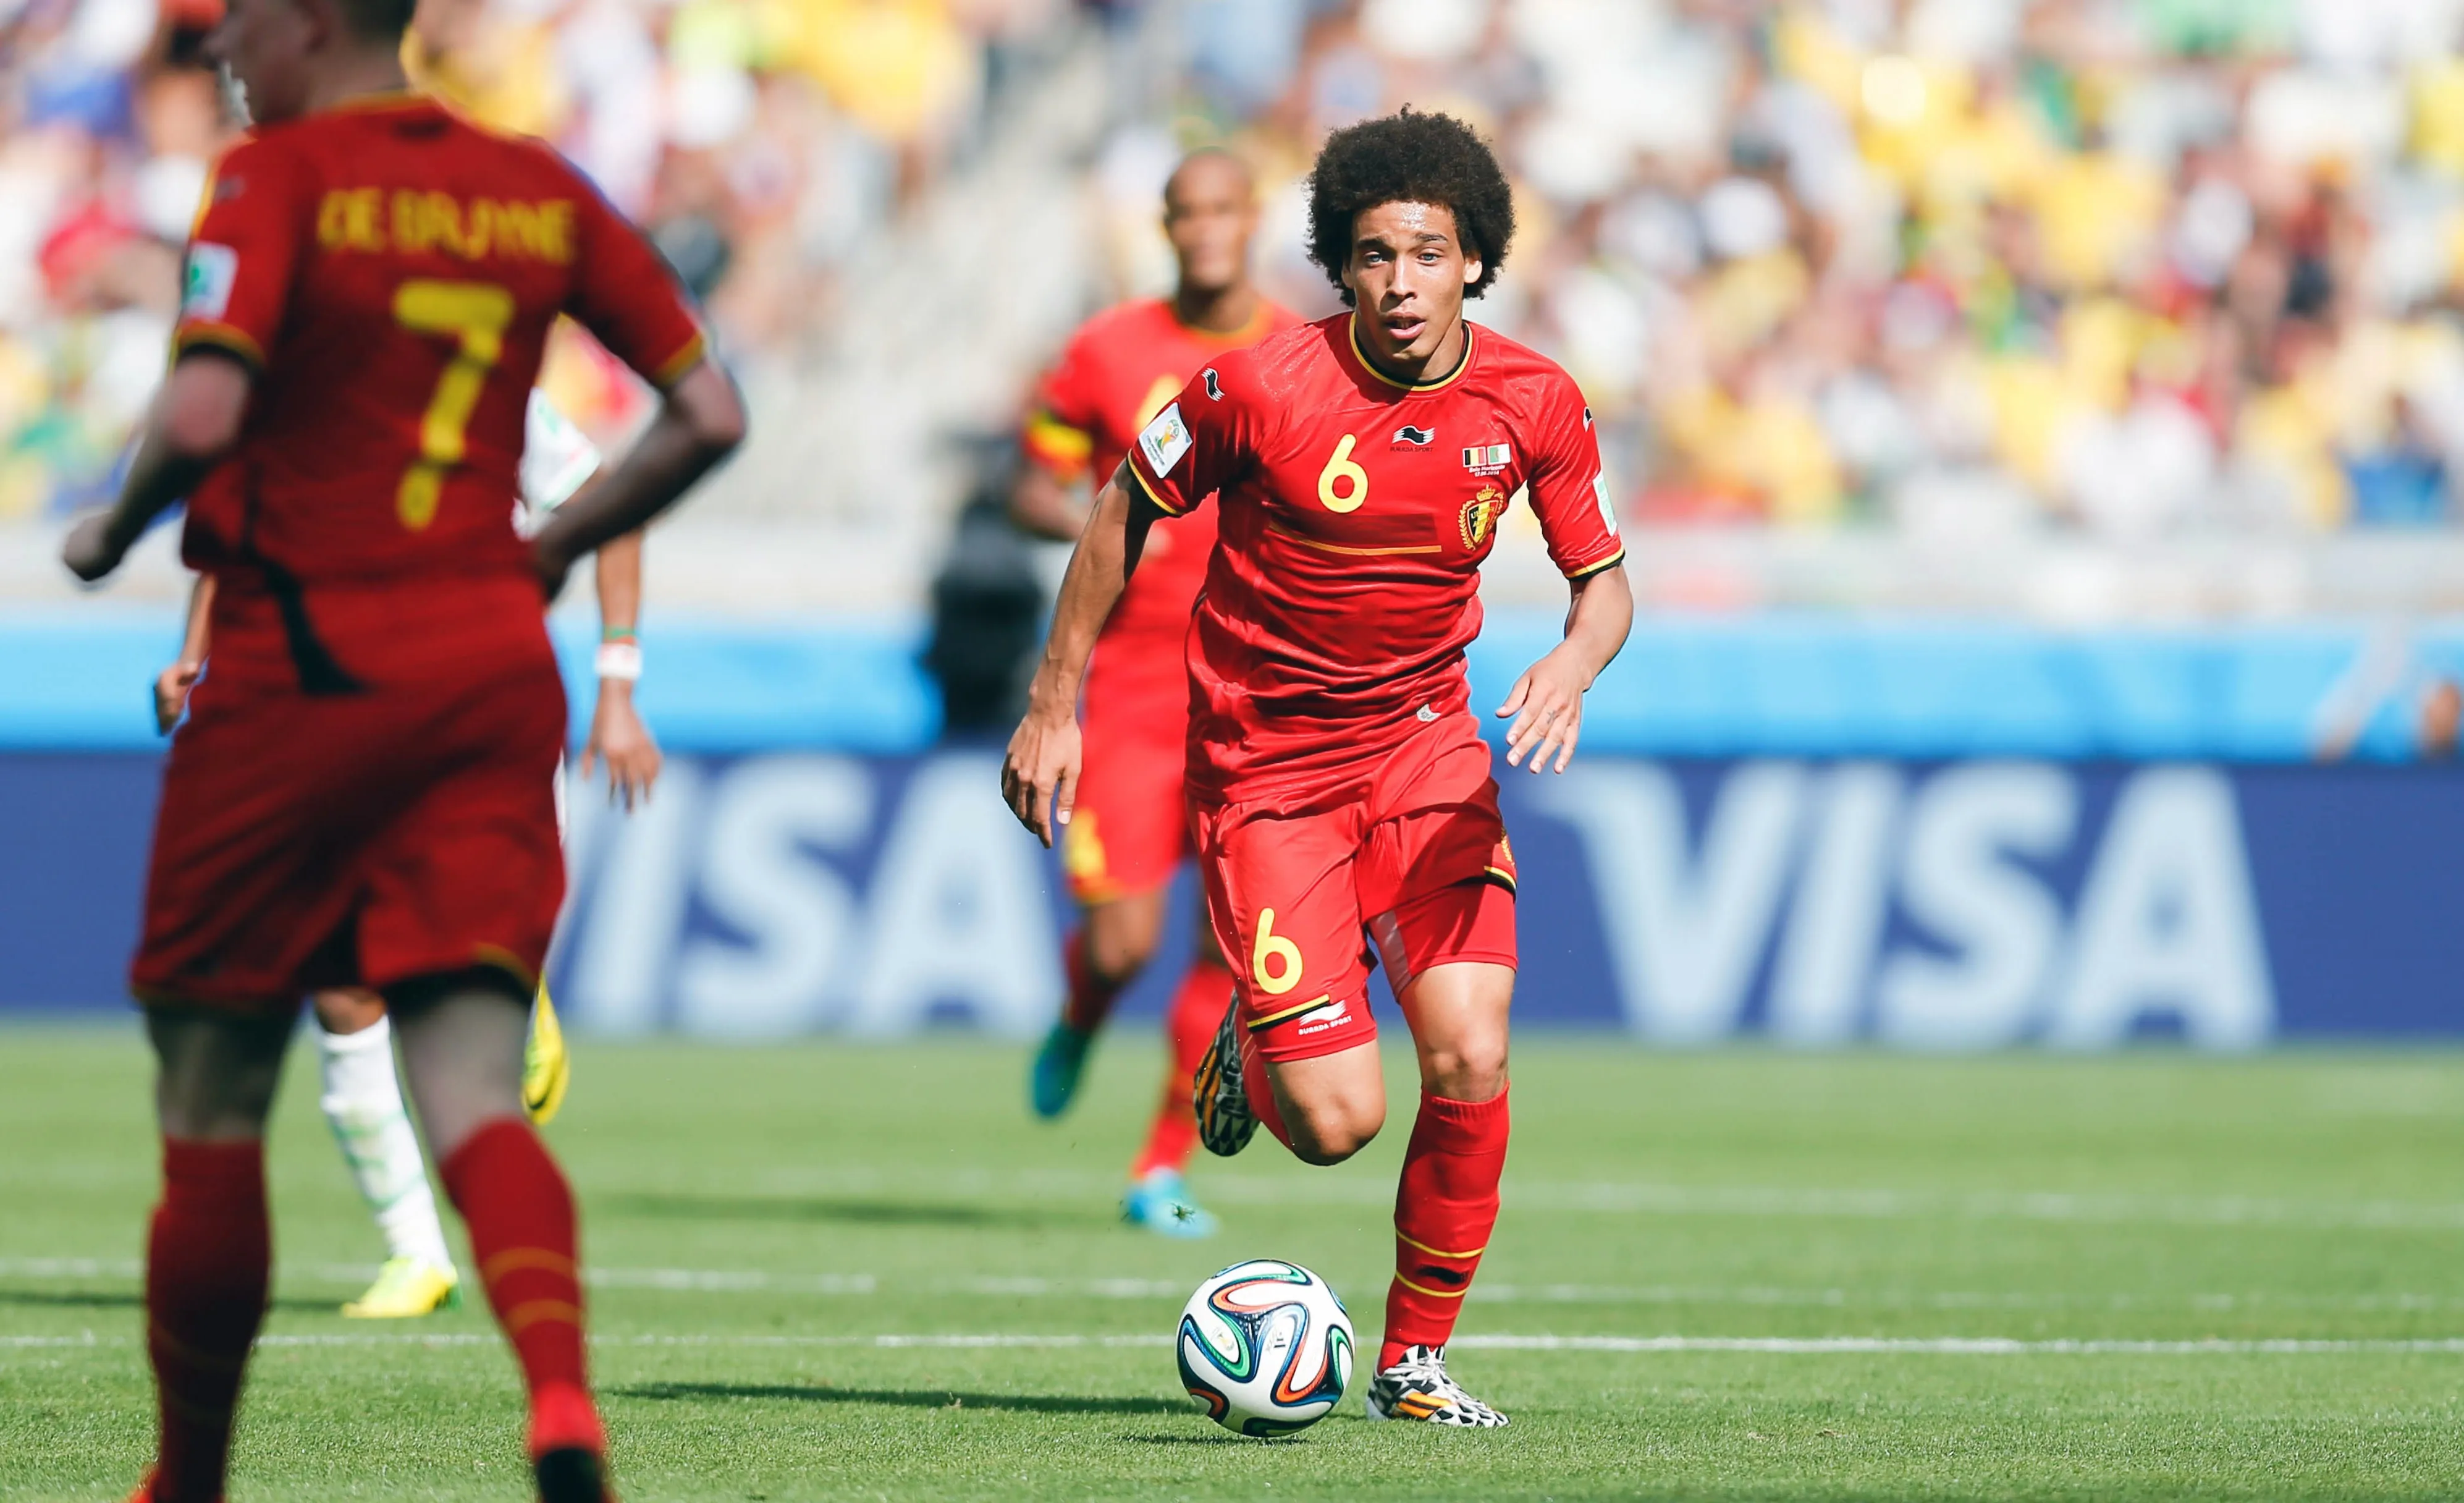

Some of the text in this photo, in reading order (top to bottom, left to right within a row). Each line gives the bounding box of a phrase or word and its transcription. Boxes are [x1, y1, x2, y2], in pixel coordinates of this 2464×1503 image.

[316, 188, 575, 265] DE BRUYNE
[393, 279, 514, 530] 7
[1317, 433, 1369, 514] 6
[1529, 758, 2279, 1048] VISA
[1254, 907, 1302, 994] 6
[1298, 1015, 1352, 1035] BURRDA SPORT
